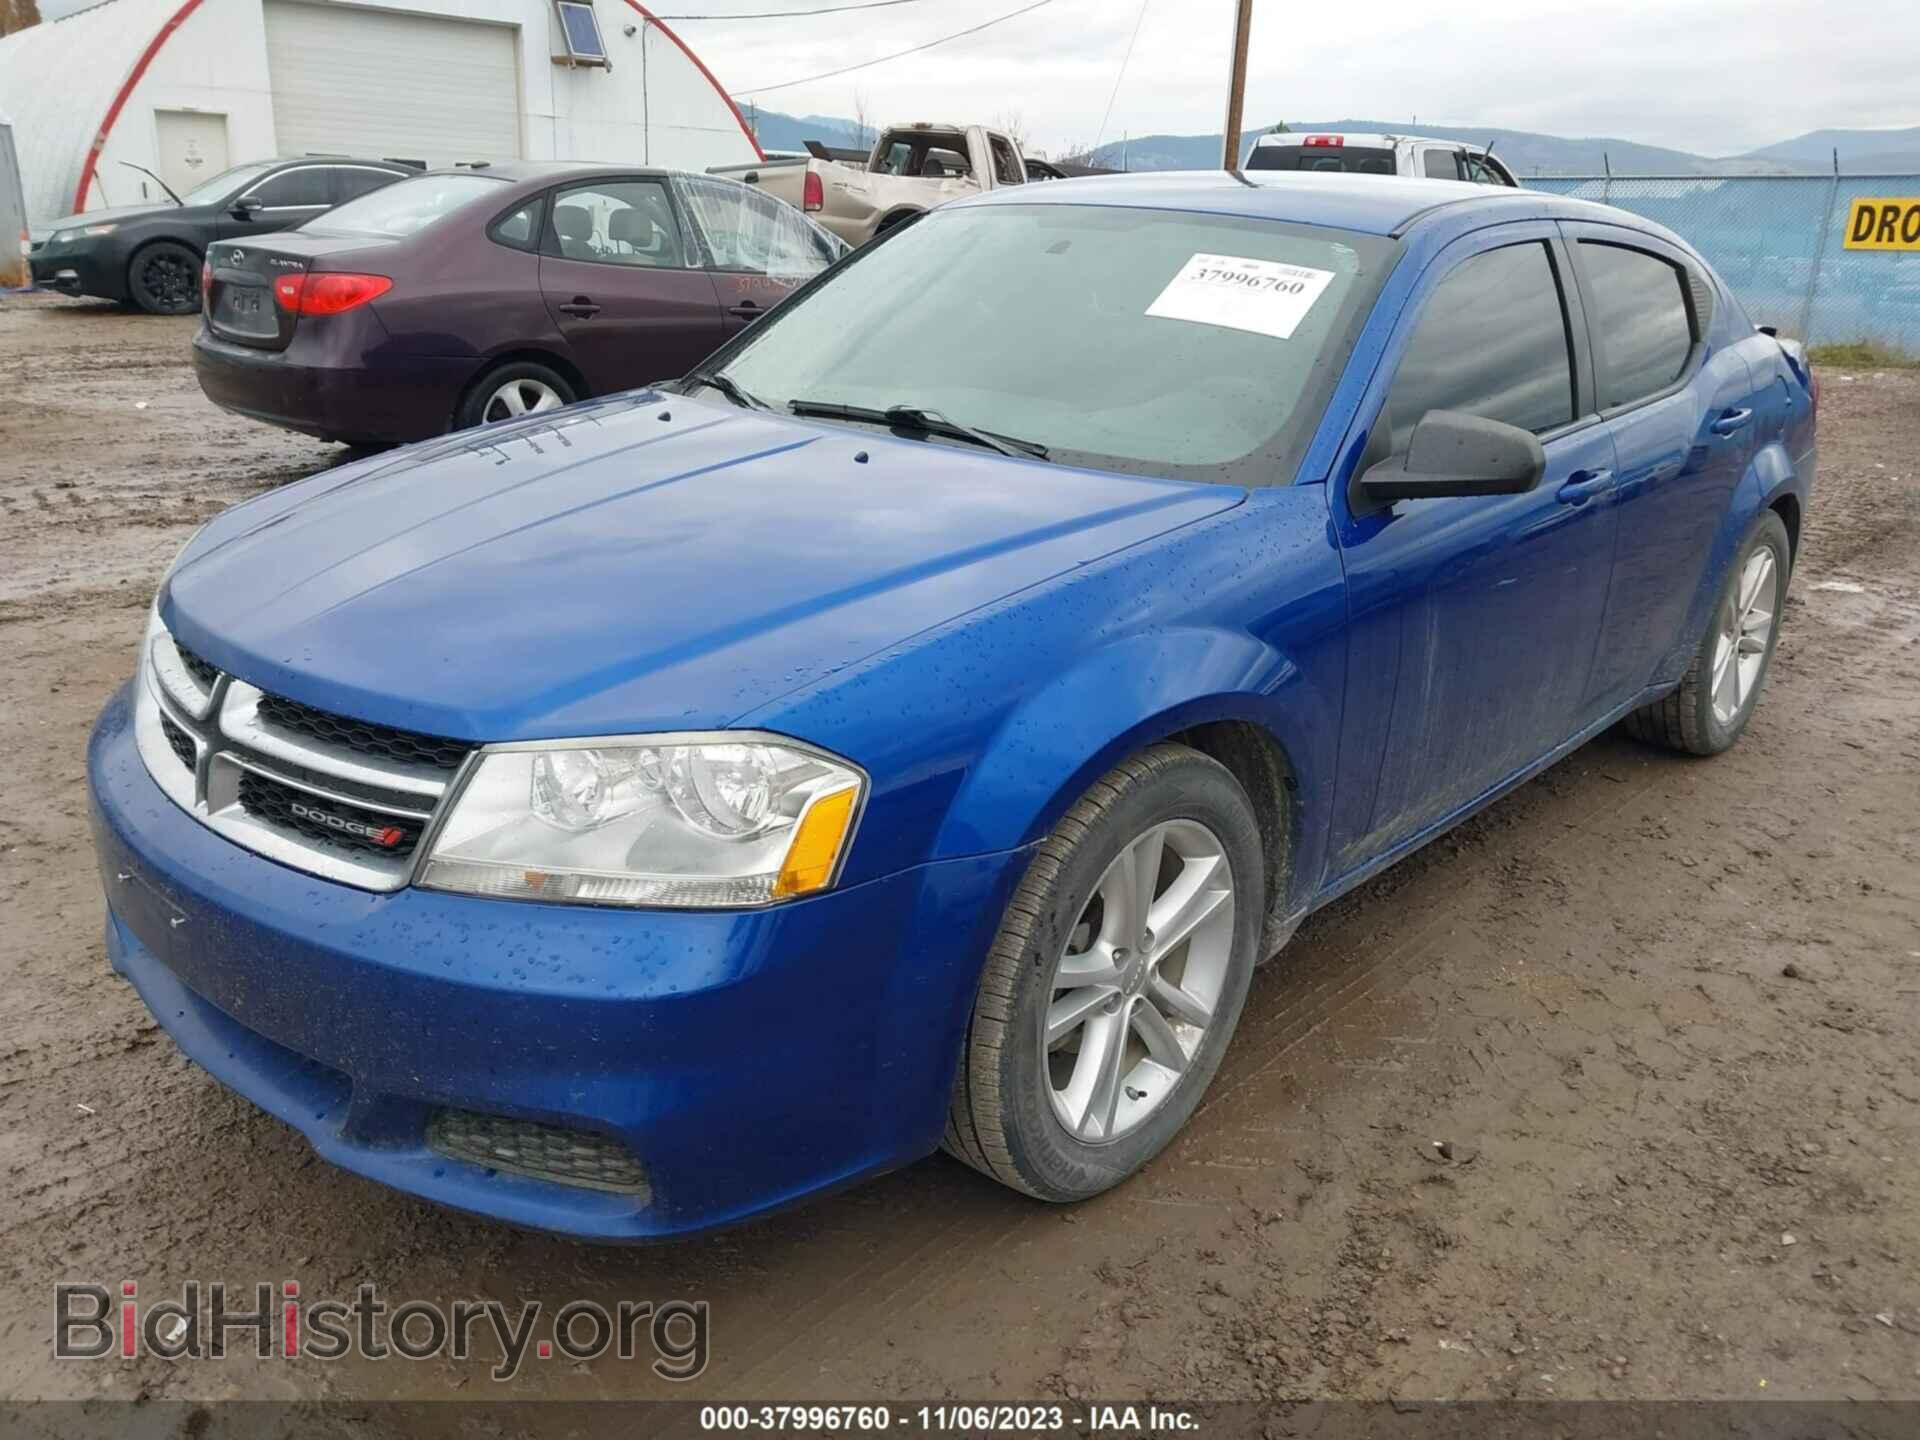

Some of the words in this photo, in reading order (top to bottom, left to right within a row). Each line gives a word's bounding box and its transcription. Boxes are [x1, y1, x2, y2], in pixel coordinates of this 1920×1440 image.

[1851, 204, 1920, 243] DRO
[1191, 267, 1306, 296] 37996760
[290, 802, 385, 842] DODGE
